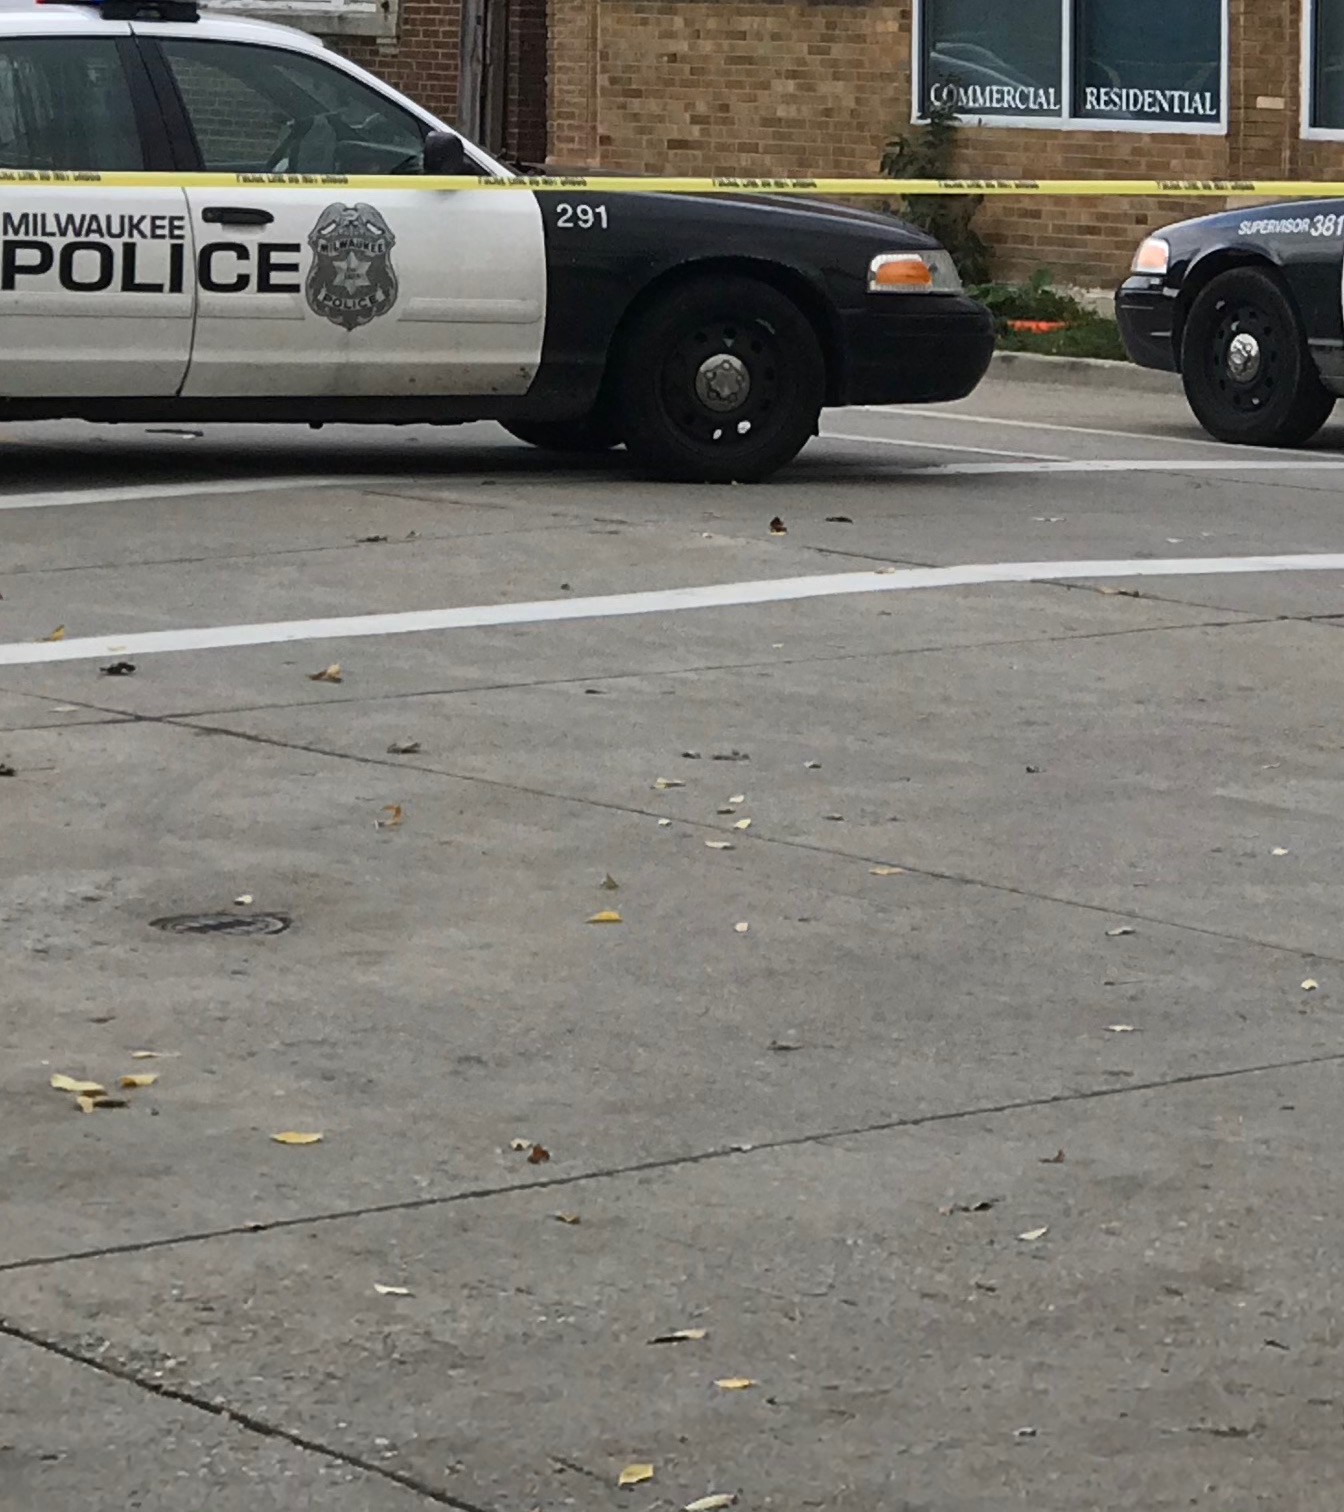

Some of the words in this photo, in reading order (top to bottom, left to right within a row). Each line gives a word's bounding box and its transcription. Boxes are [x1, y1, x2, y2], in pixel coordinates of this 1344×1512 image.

[930, 82, 1061, 109] COMMERCIAL
[1086, 87, 1216, 115] RESIDENTIAL
[2, 212, 185, 239] MILWAUKEE
[556, 203, 608, 229] 291
[1238, 218, 1310, 235] SUPERVISOR
[320, 238, 384, 253] MILWAUKEE
[1, 240, 301, 294] POLICE
[323, 293, 378, 309] POLICE
